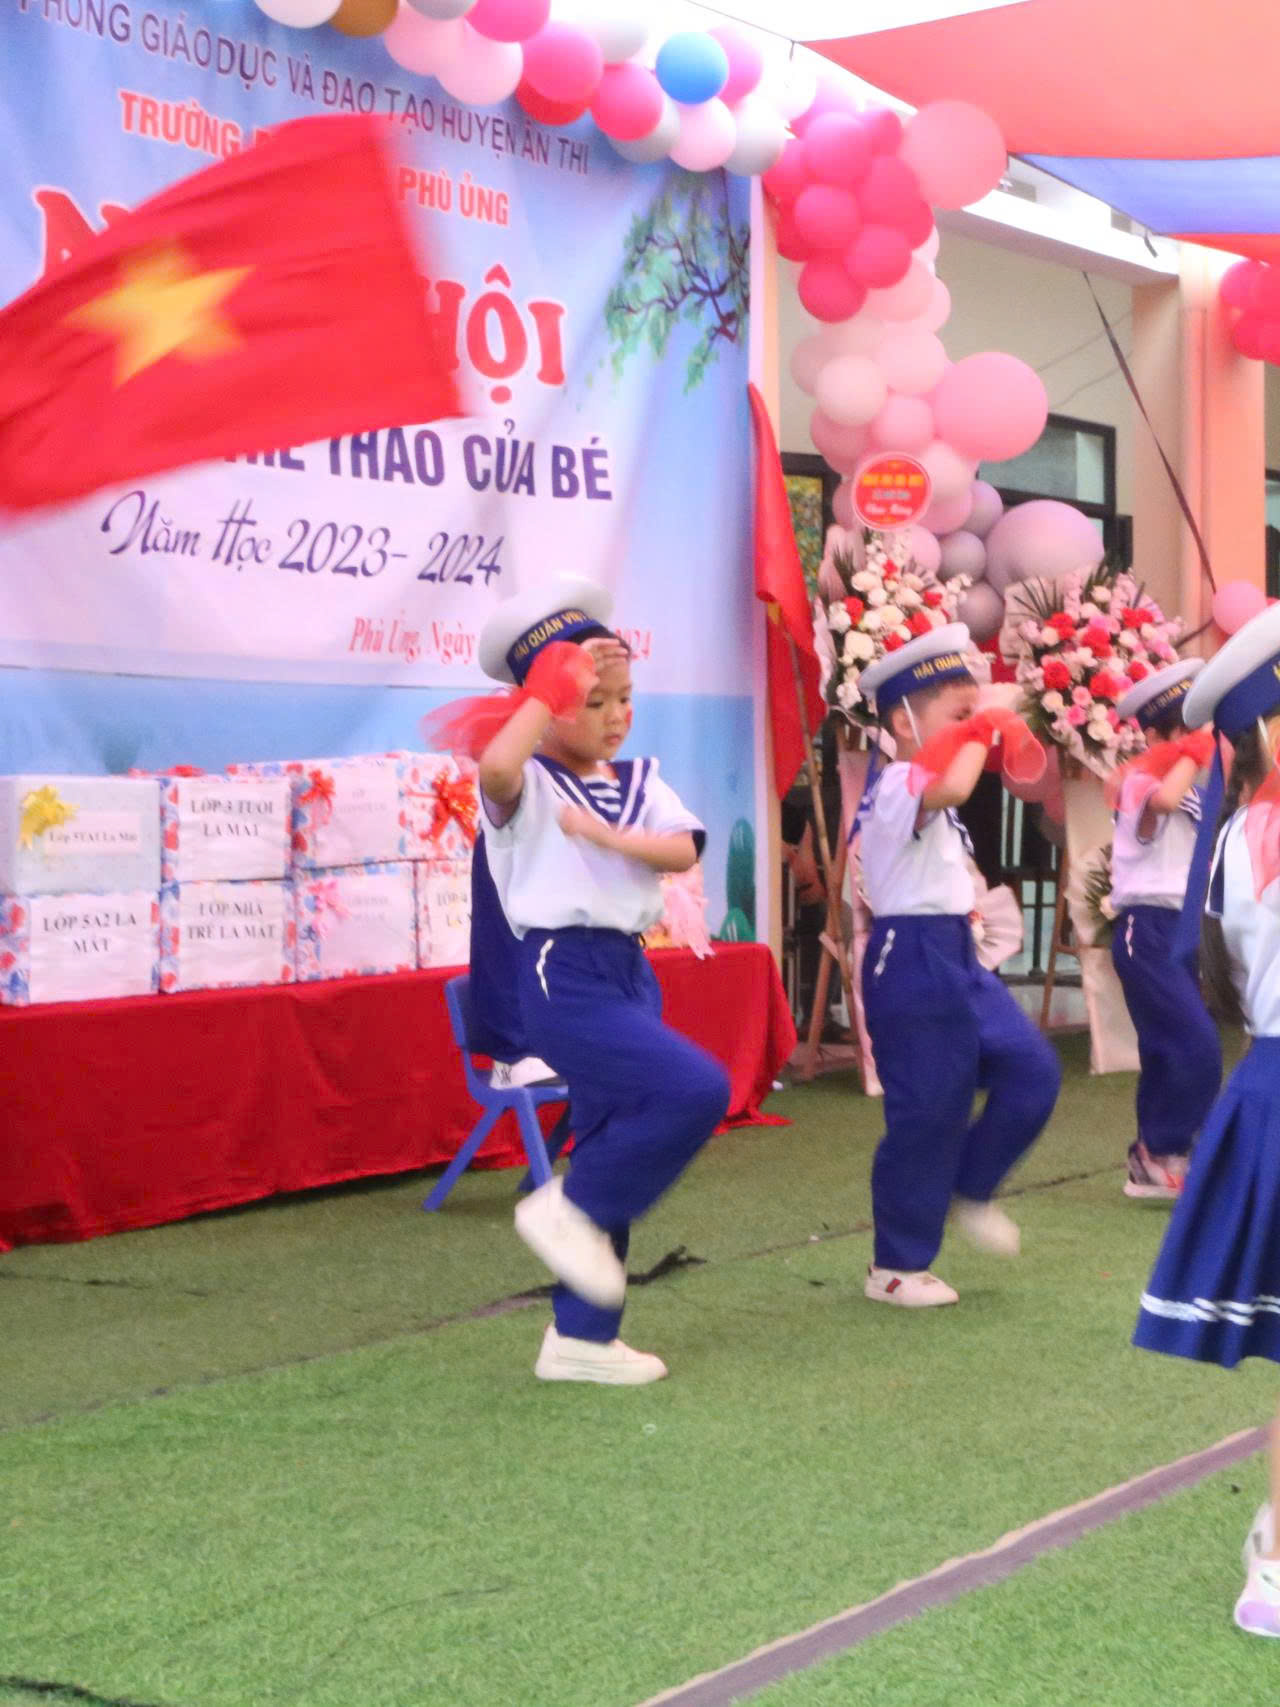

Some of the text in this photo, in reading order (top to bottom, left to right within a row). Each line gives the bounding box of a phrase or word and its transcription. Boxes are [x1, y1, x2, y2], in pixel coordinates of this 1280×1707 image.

[288, 53, 315, 99] VÀ
[400, 167, 452, 211] PHÙ
[463, 419, 536, 496] CỦA
[551, 437, 612, 500] BÉ
[101, 490, 200, 554] Năm
[212, 499, 271, 572] Học
